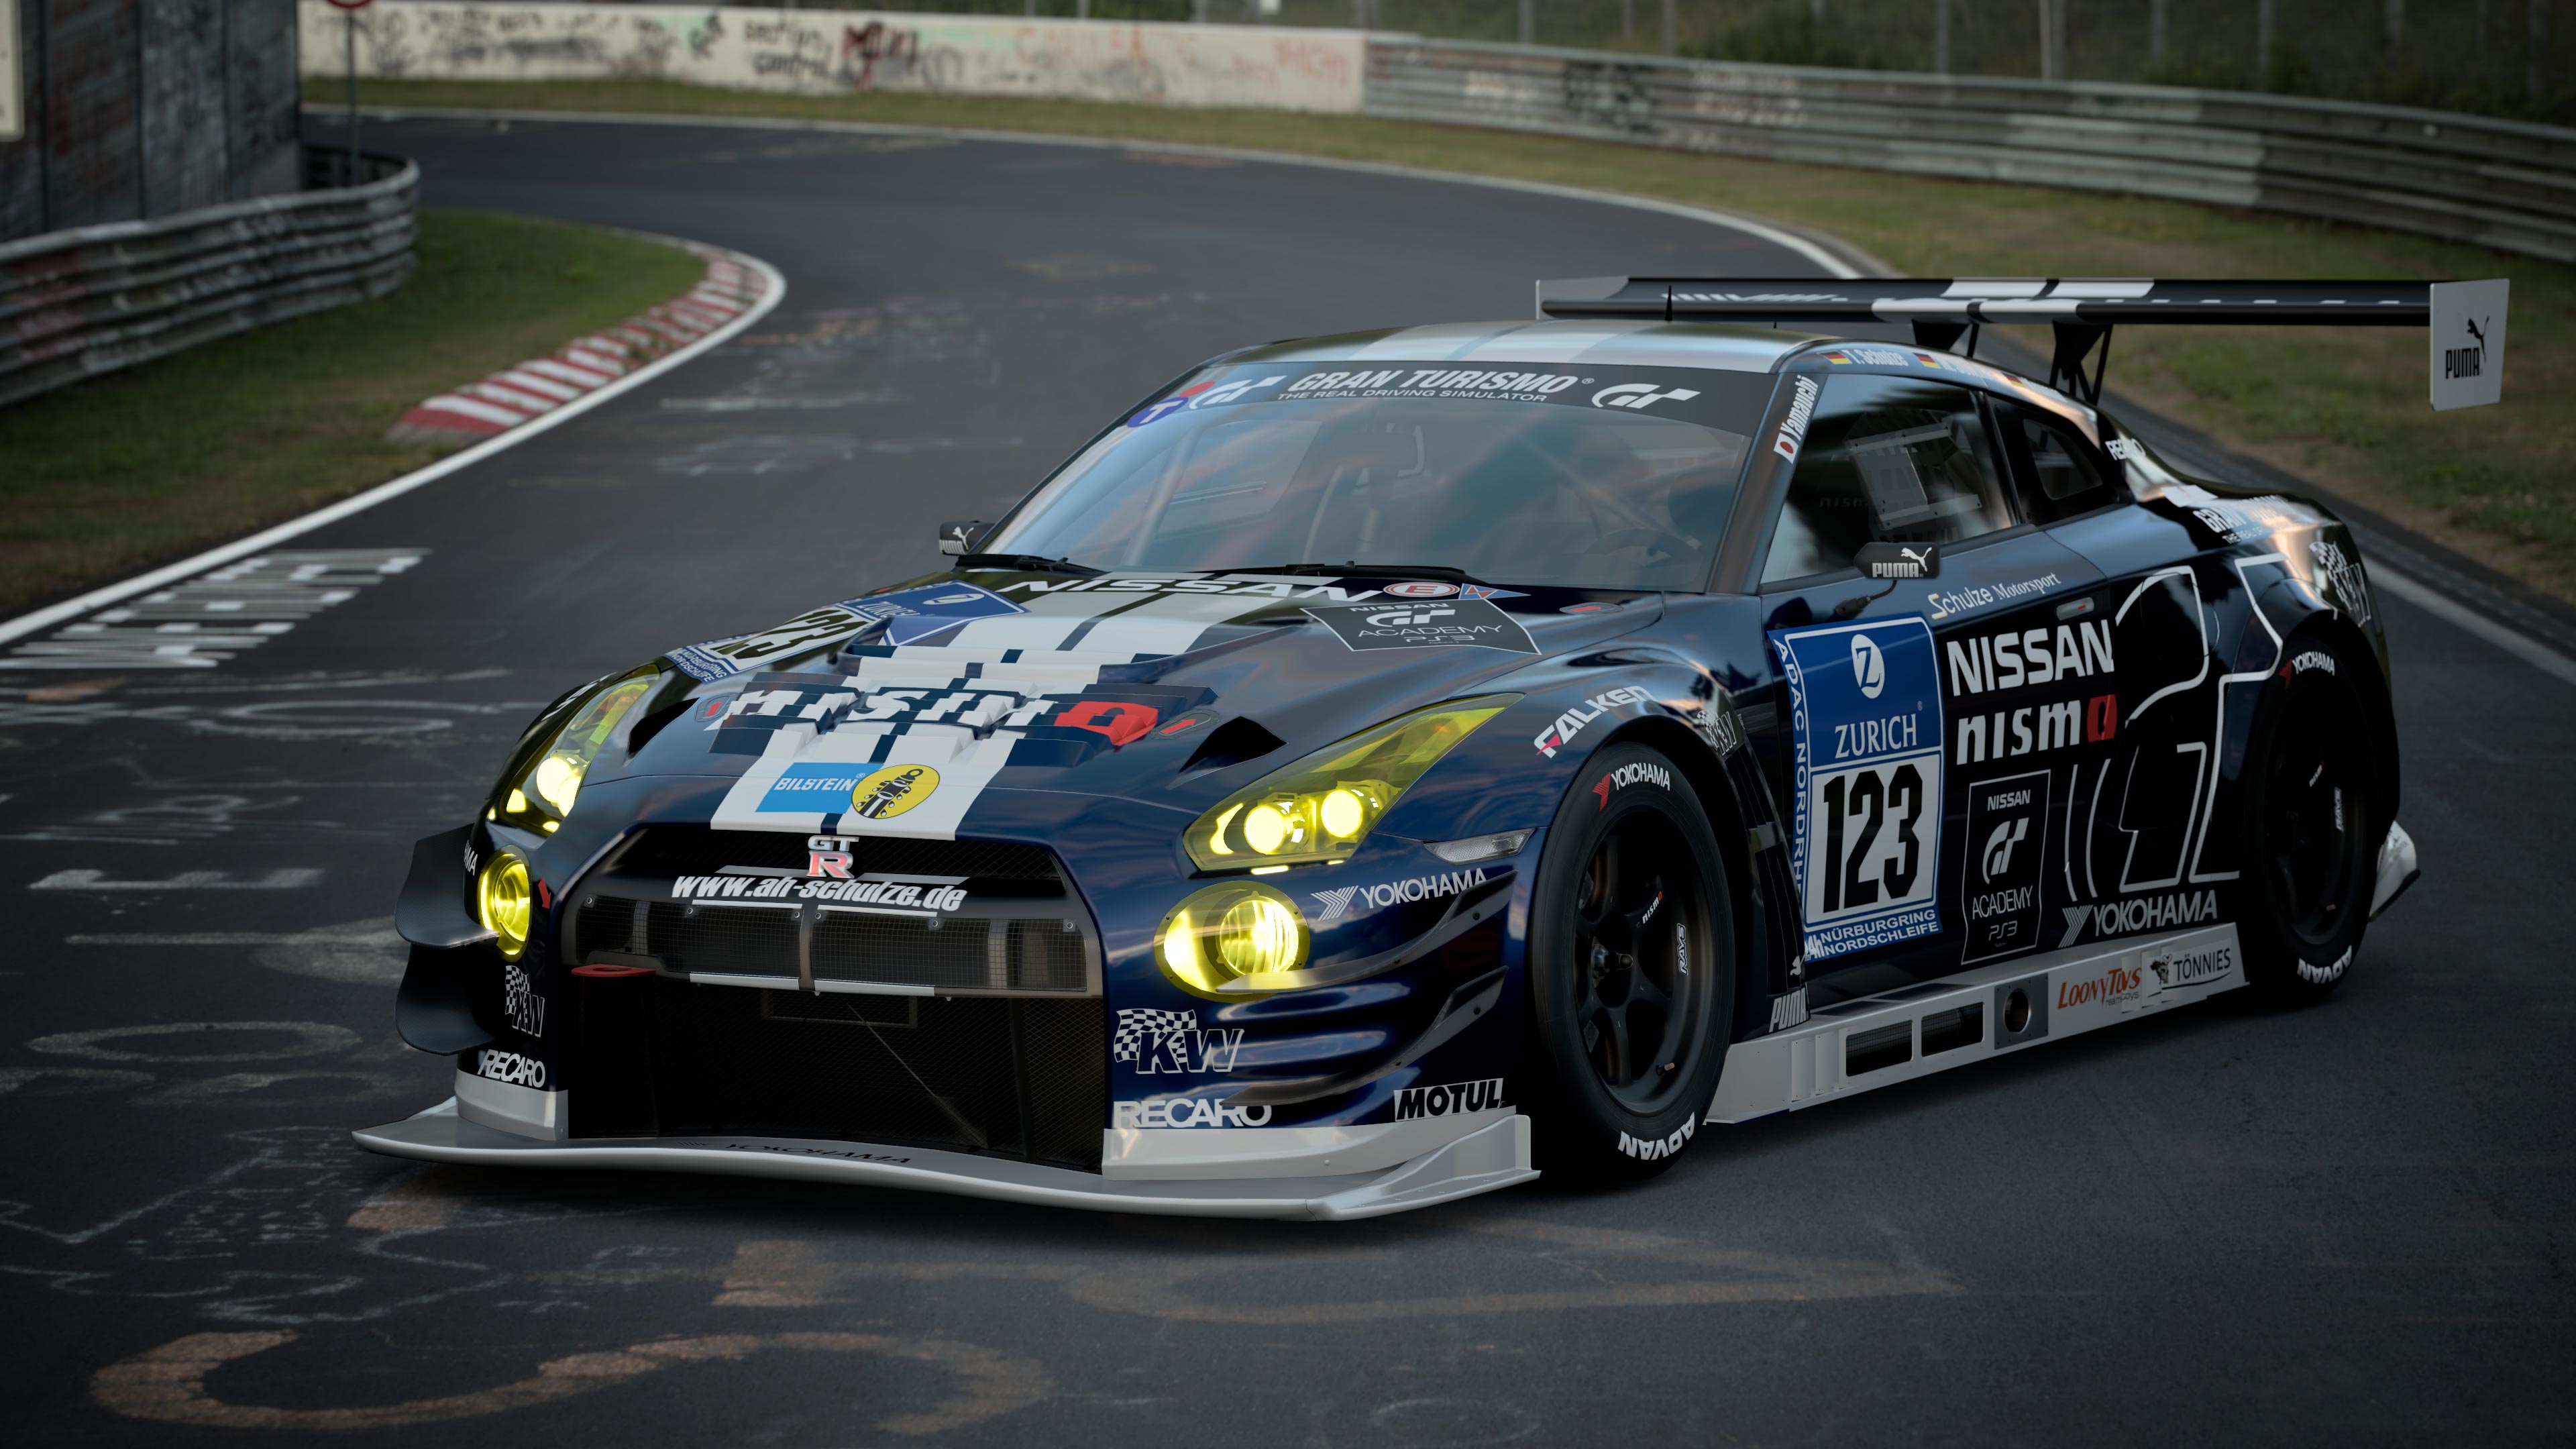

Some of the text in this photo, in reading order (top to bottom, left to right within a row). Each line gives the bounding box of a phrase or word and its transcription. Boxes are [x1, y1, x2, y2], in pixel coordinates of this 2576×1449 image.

[2446, 347, 2480, 380] PUMA
[1278, 389, 1548, 402] THE REAL DRIVING SIMULATOR
[1288, 370, 1578, 393] GRAN TURISMO
[1780, 374, 1819, 441] Yamauchi
[1872, 562, 1919, 578] PUMA
[994, 579, 1385, 602] NISSAN
[1349, 603, 1450, 612] NISSAN
[1928, 572, 2061, 619] Schulze Motorsport
[1358, 624, 1503, 637] ACADEMY
[1403, 635, 1476, 643] PS3
[1946, 619, 2115, 697] NISSAN
[2292, 650, 2336, 676] YOKOHAMA
[1773, 638, 1805, 731] ADAC
[1534, 686, 1658, 759] FALKEN
[1834, 713, 1918, 759] ZURICH
[1956, 694, 2118, 766] nismo
[773, 777, 859, 792] BILSTEIN
[1611, 762, 1670, 792] YOKOHAMA
[1987, 789, 2031, 812] NISSAN
[807, 835, 860, 852] GT
[1823, 763, 1923, 913] 123
[1359, 867, 1488, 909] YOKOHAMA
[1972, 884, 2034, 920] ACADEMY
[1642, 890, 1663, 924] nismo
[2093, 889, 2218, 938] YOKOHAMA
[1820, 909, 1936, 944] NÜRBURGRING
[1823, 921, 1939, 956] NORDSCHLEIFE
[1988, 920, 2019, 942] PS3
[1677, 923, 1689, 976] RAYS
[2174, 947, 2231, 981] TÖNNIES
[2297, 945, 2353, 985] ADVAN
[1768, 987, 1807, 1033] PUMA
[476, 1049, 546, 1088] RECARO
[1135, 1028, 1245, 1075] KW
[1112, 1097, 1273, 1128] RECARO
[1396, 1079, 1500, 1120] MOTUL
[1617, 1111, 1697, 1161] ADVAN
